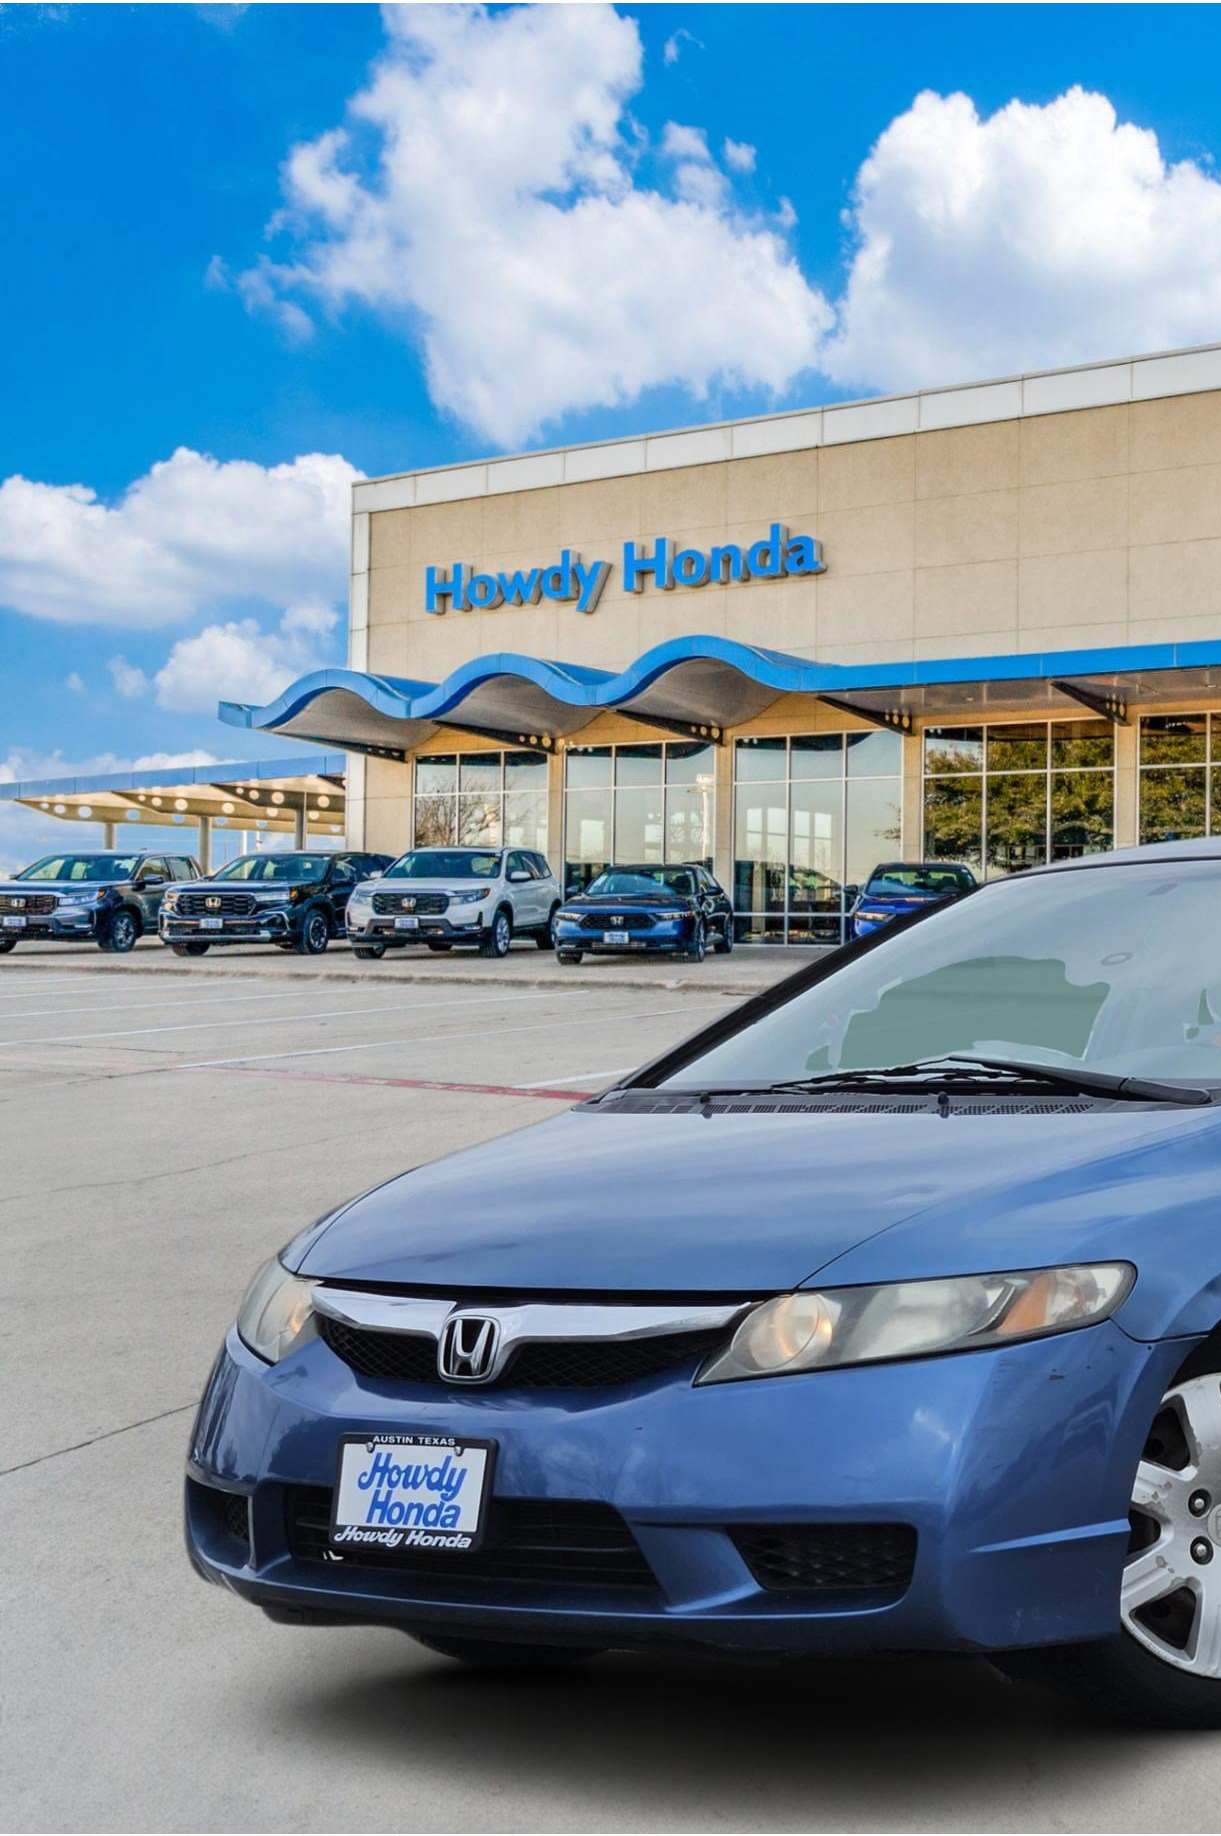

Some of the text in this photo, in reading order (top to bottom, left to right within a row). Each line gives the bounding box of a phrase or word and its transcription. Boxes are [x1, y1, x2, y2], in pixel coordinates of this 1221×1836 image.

[425, 523, 827, 614] Howdy Honda
[373, 1435, 456, 1446] AUSTIN TEXAS
[358, 1452, 467, 1501] Howdy
[365, 1489, 461, 1529] Honda
[334, 1526, 472, 1549] Howdy Honda
